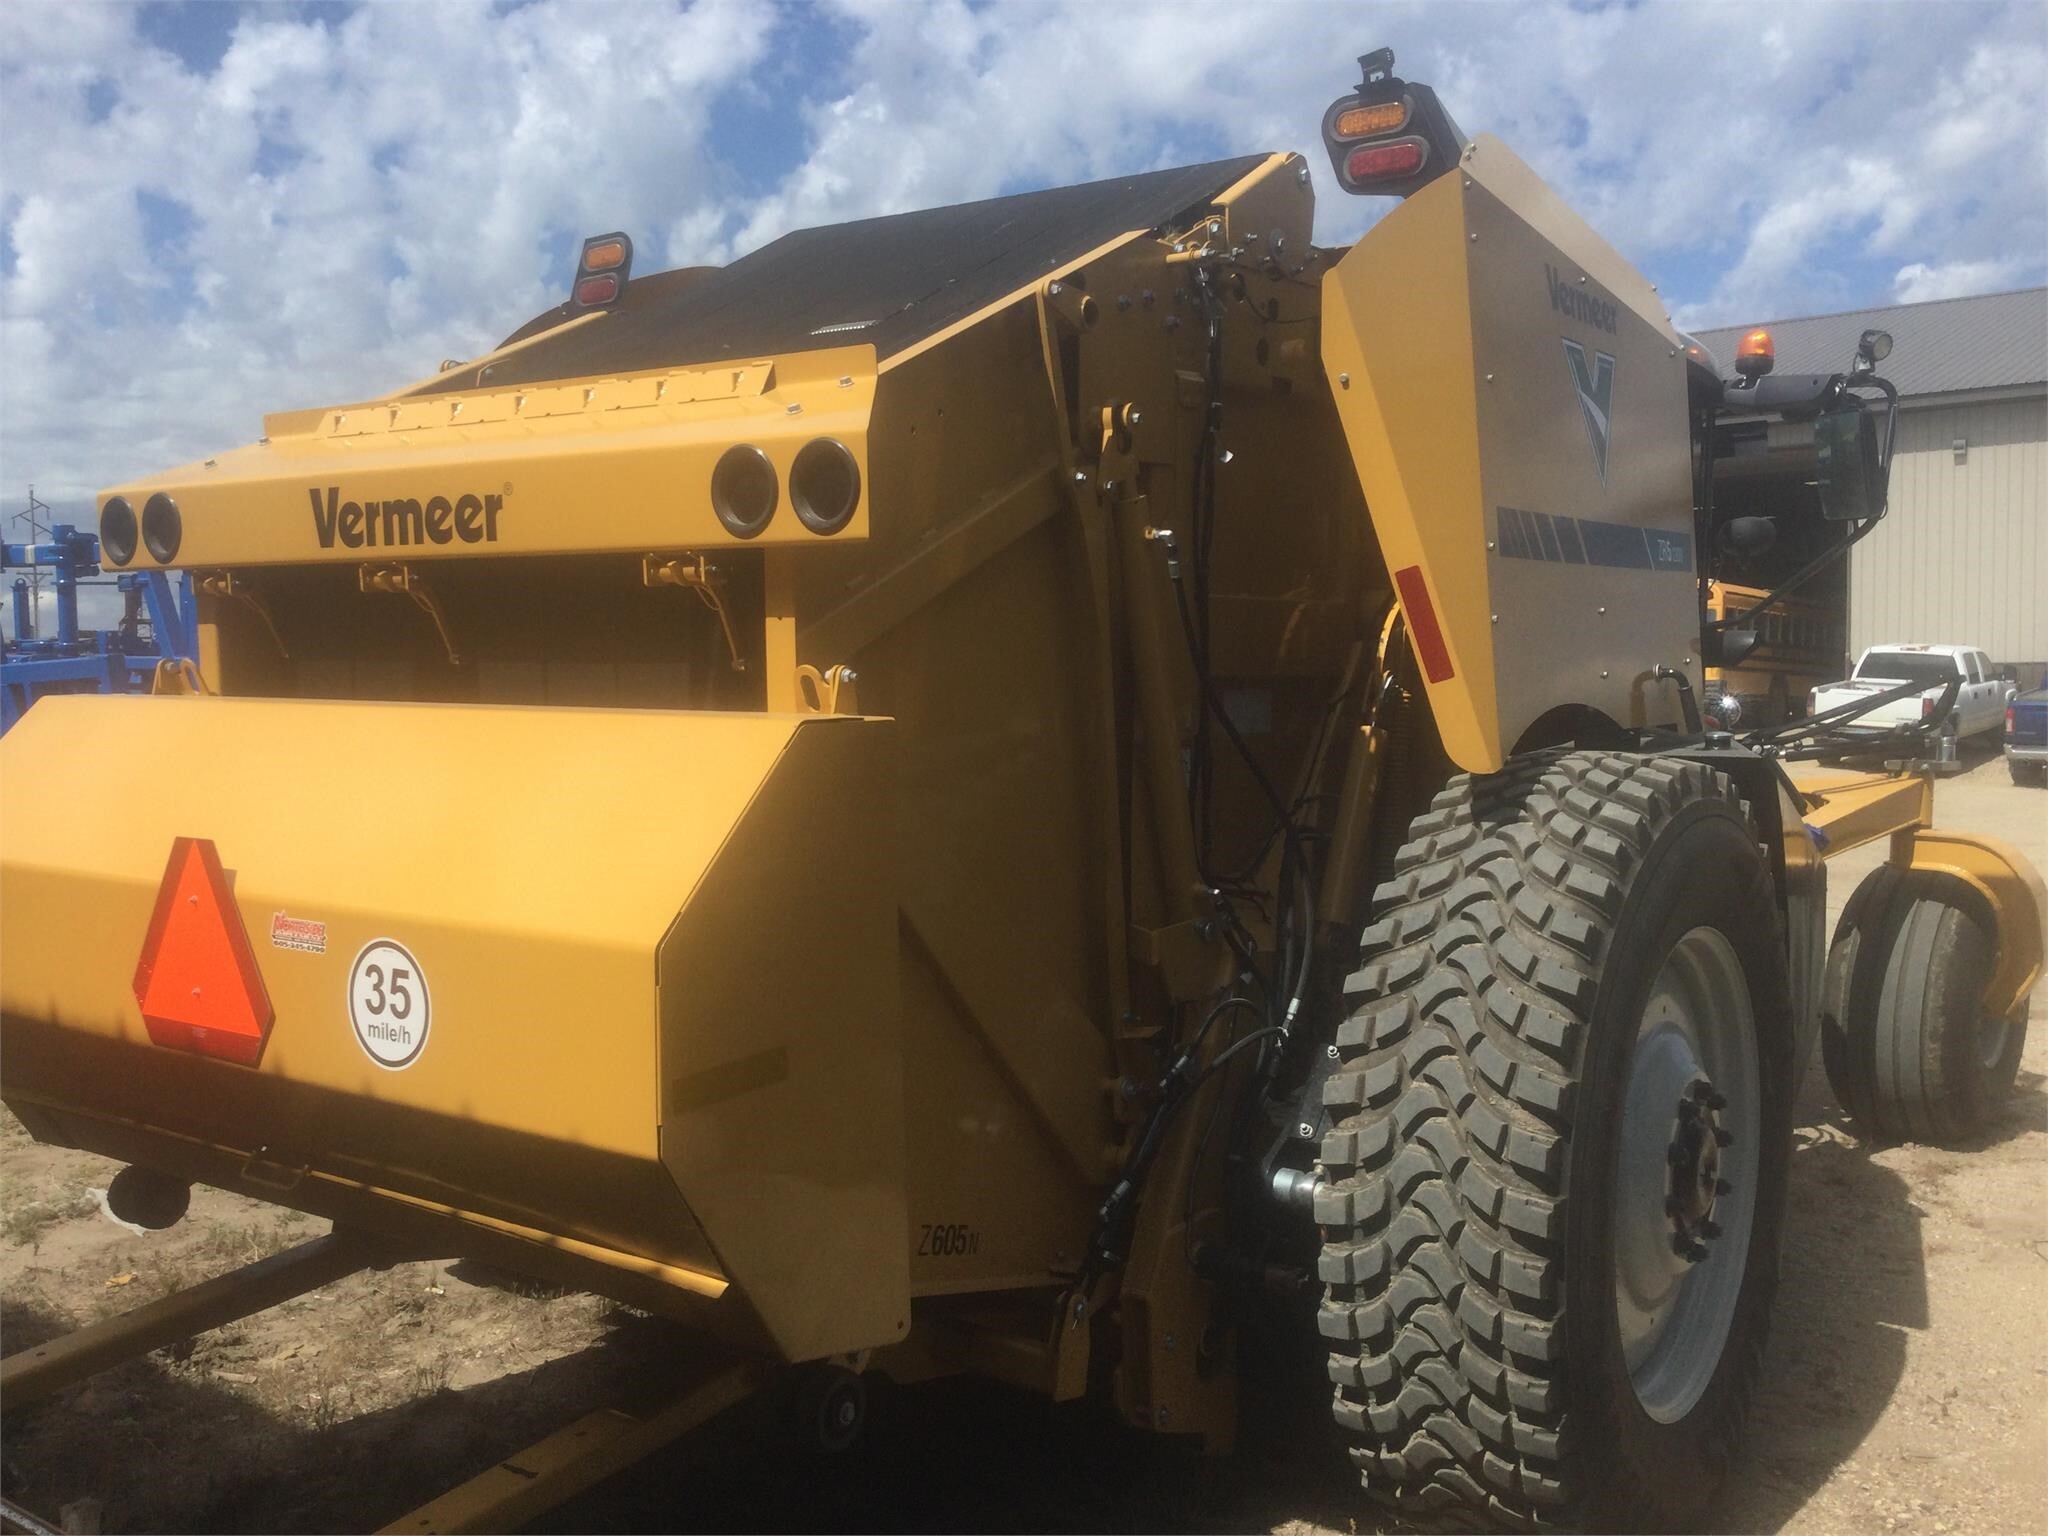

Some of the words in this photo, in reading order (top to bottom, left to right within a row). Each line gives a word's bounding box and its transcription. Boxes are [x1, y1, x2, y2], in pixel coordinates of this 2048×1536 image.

[1544, 262, 1617, 335] Vermeer
[309, 486, 504, 549] Vermeer
[364, 963, 412, 1020] 35
[367, 1022, 412, 1045] mile/h
